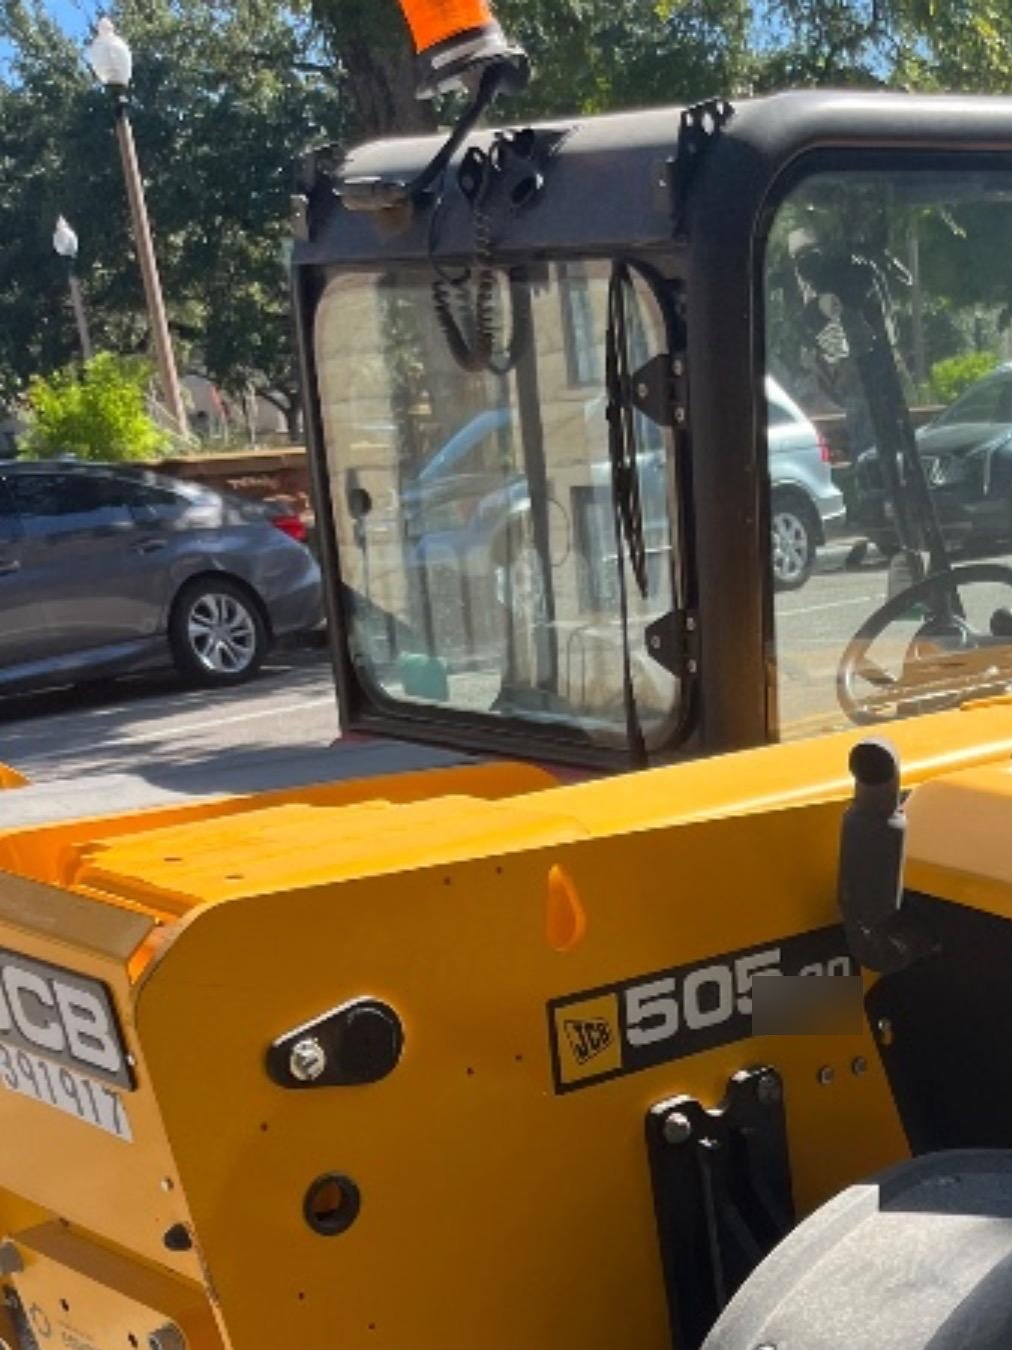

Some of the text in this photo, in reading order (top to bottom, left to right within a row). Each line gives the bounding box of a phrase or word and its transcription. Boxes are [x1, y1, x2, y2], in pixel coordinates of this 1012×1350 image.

[0, 964, 122, 1073] CB
[574, 1022, 609, 1057] JCB
[0, 1043, 122, 1135] 391917
